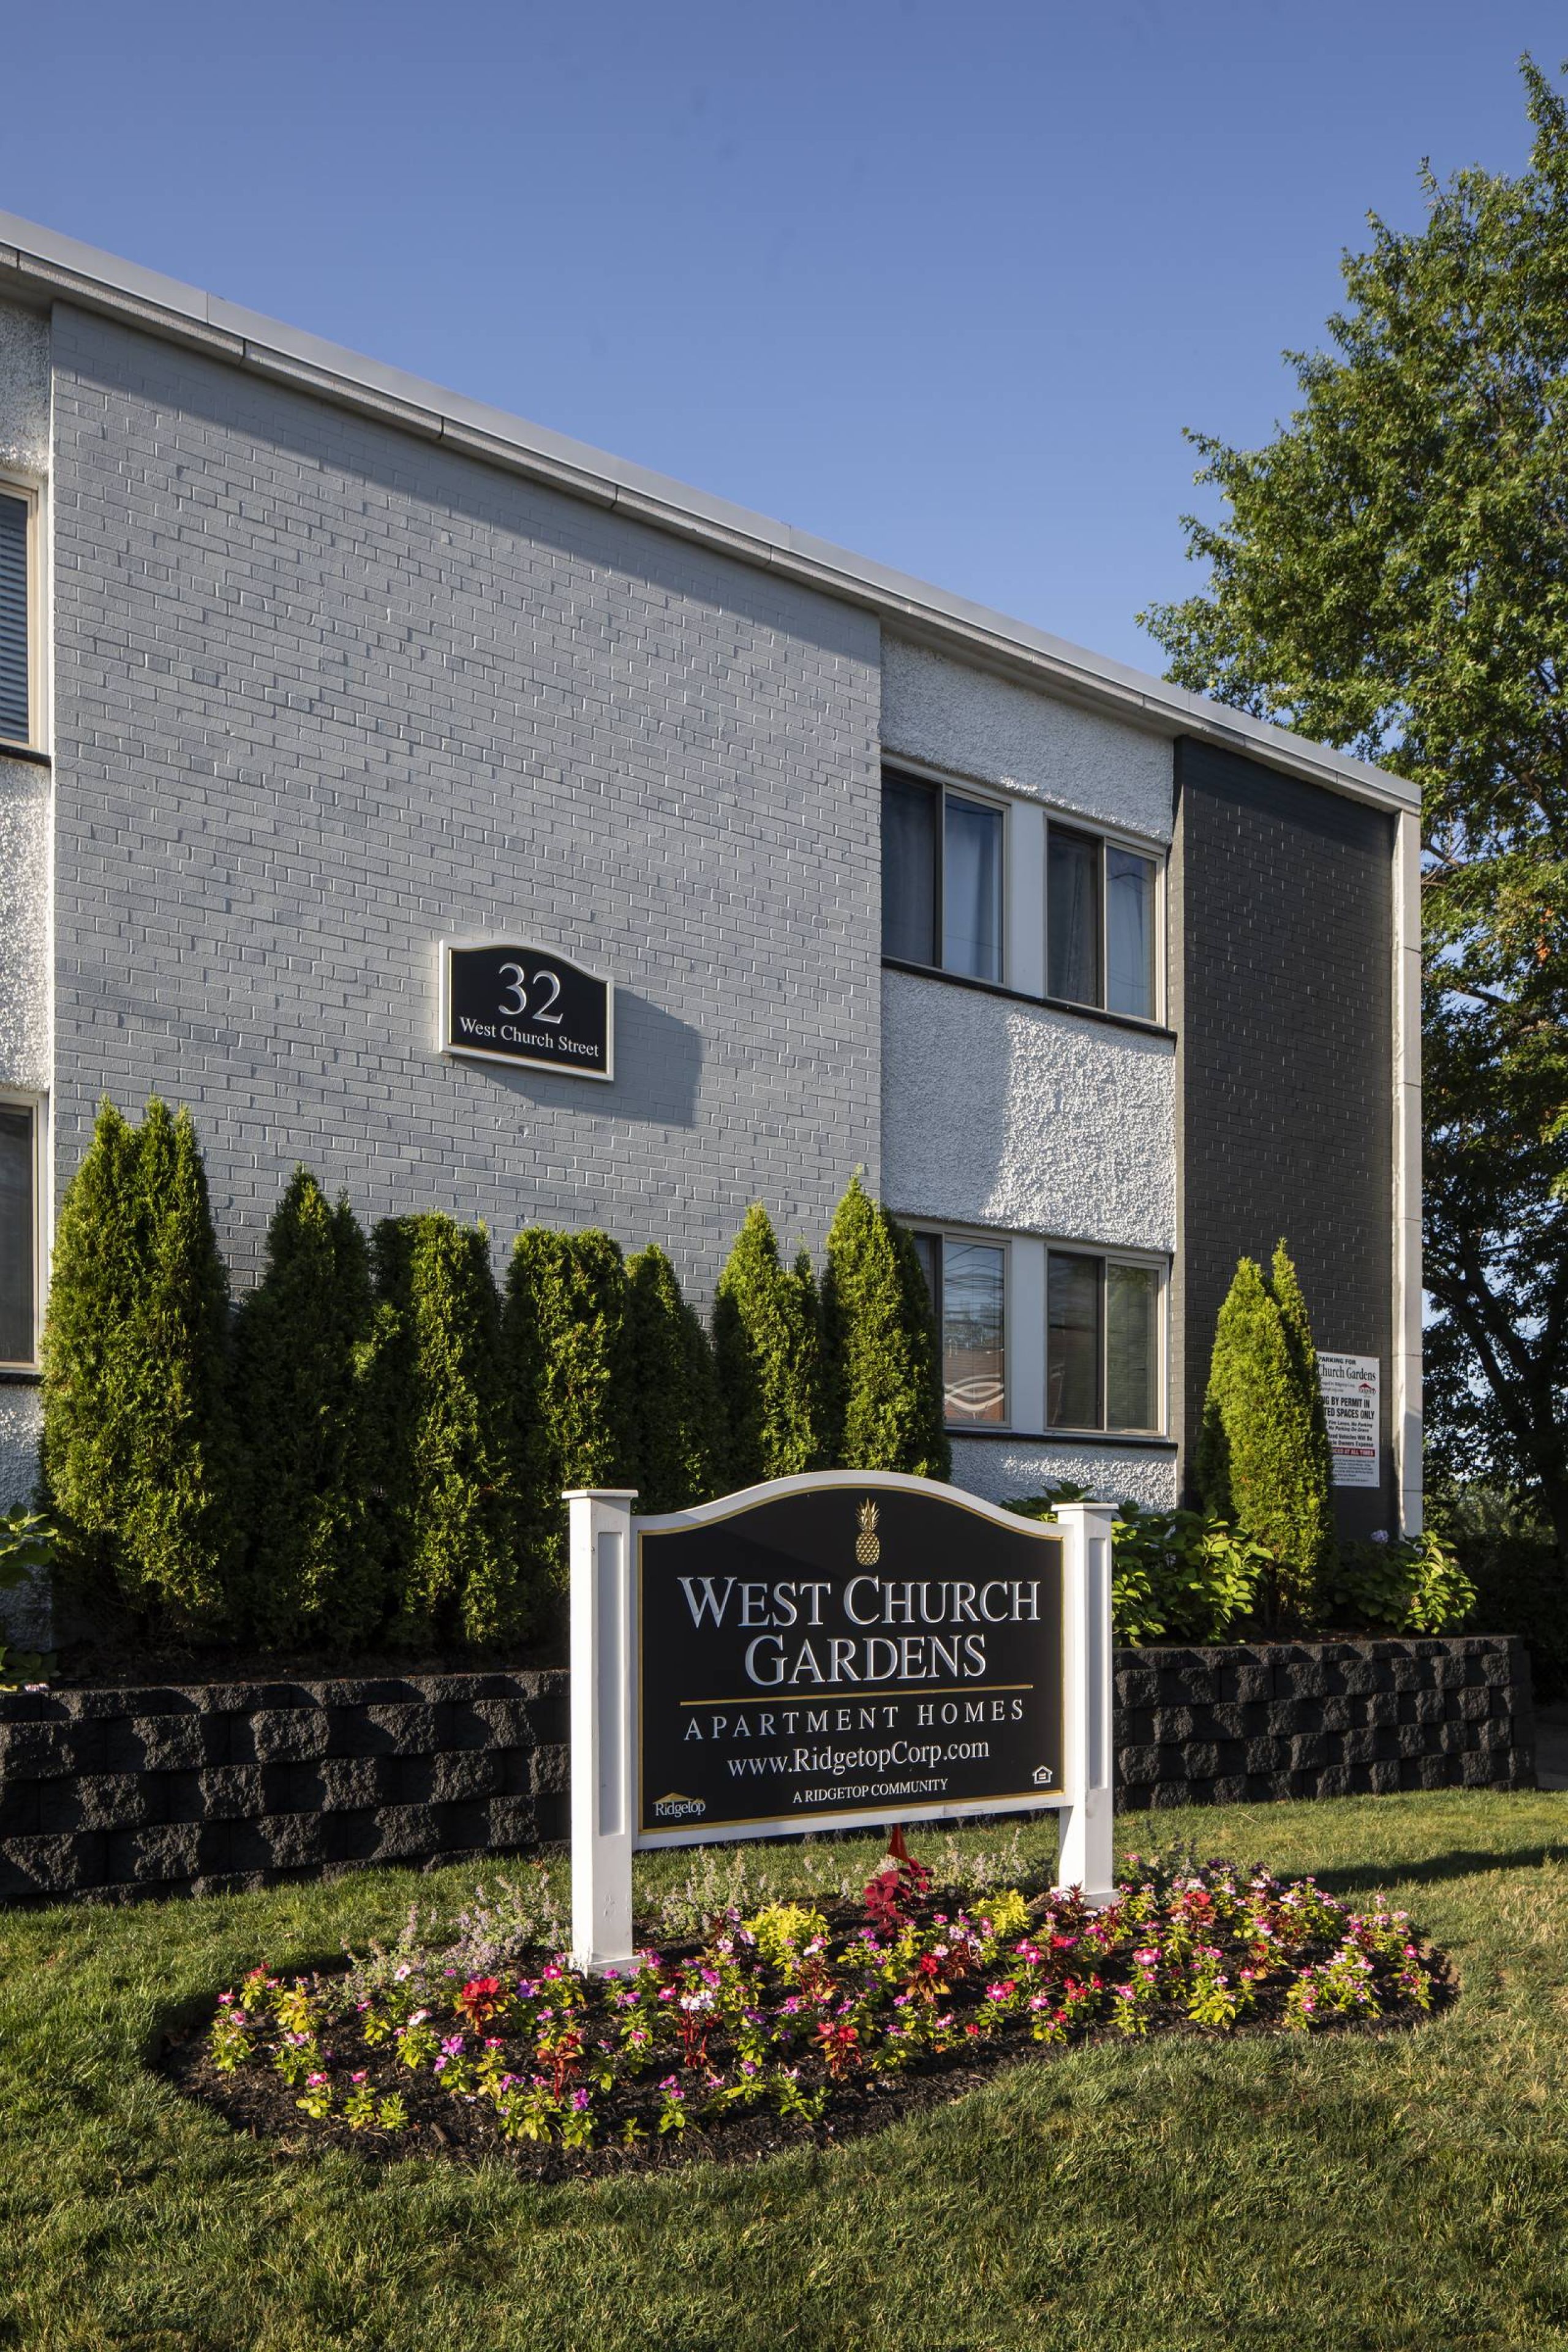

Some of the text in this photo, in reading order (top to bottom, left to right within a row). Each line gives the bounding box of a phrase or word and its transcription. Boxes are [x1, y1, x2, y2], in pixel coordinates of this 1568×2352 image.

[499, 962, 564, 1024] 32
[459, 1016, 599, 1057] West Church Street
[1317, 1363, 1376, 1381] Church Gardens
[1331, 1396, 1340, 1406] BY
[1340, 1397, 1363, 1408] PERMIT
[1363, 1399, 1370, 1409] IN
[1336, 1408, 1359, 1419] SPACES
[1360, 1410, 1374, 1420] ONLY
[677, 1575, 1041, 1629] WEST CHURCH
[745, 1634, 987, 1686] GARDENS
[684, 1698, 1024, 1741] APARTMENT HOMES
[727, 1740, 990, 1777] www.RidgetopCorp.com
[655, 1800, 706, 1818] Ridgetop
[793, 1778, 949, 1804] A RIDGETOP COMMUNITY
